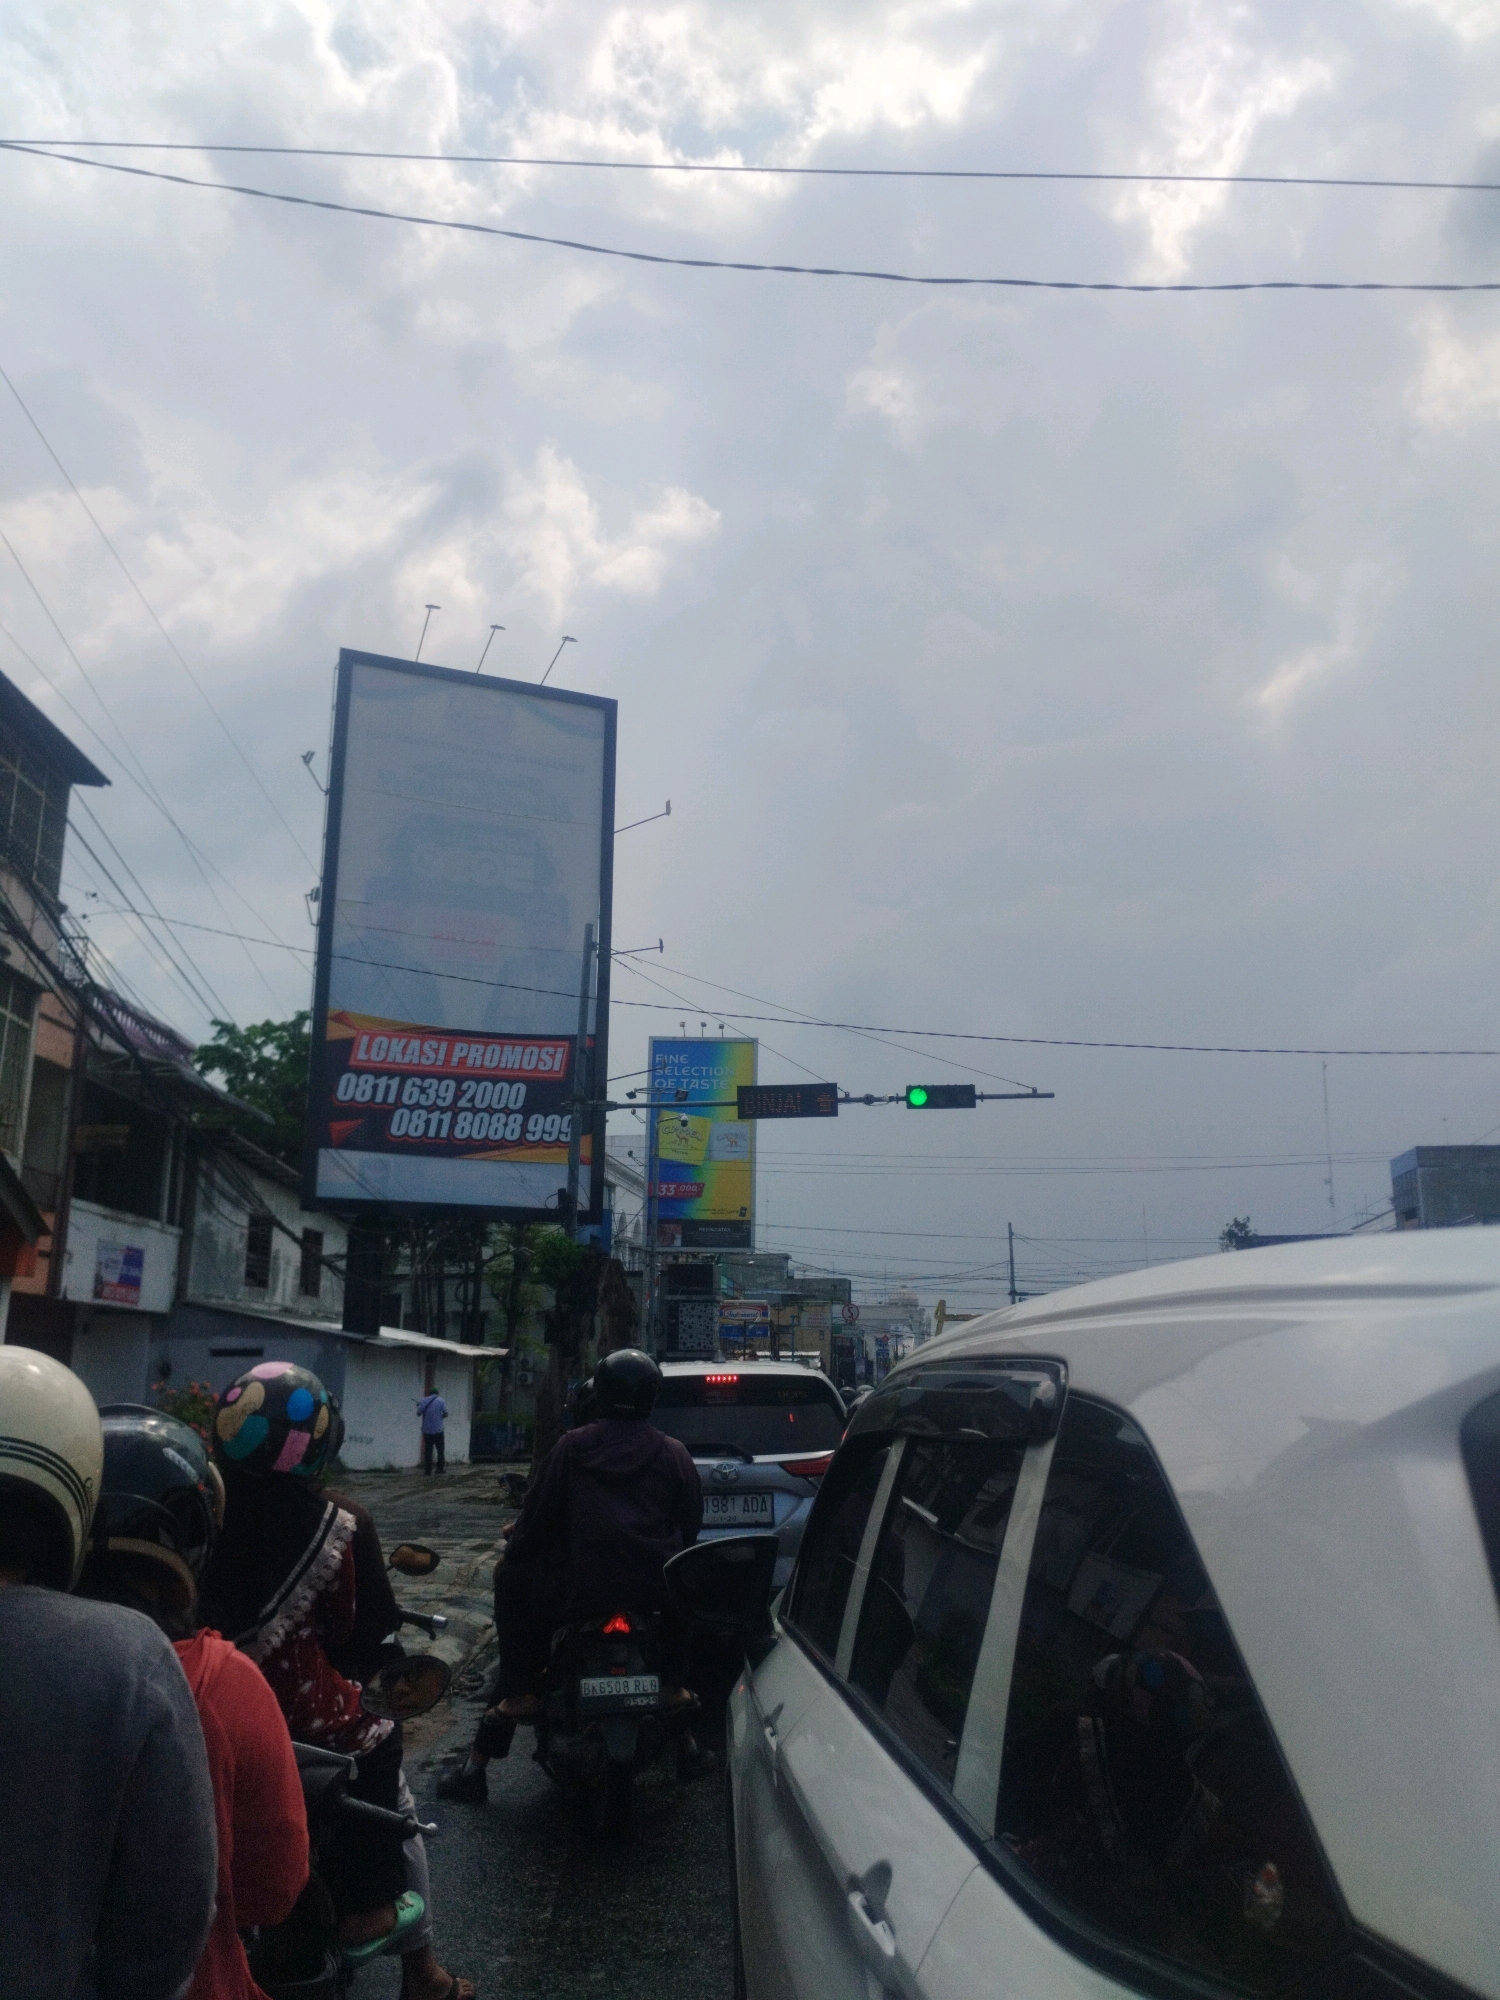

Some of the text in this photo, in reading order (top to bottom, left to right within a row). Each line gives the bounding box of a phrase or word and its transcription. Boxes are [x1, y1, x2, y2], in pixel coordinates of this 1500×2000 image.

[357, 1034, 565, 1072] LOKASI PROMOSI
[655, 1054, 689, 1064] FINE
[654, 1066, 735, 1077] SELECTION
[336, 1073, 527, 1110] 0811 639 2000
[681, 1078, 729, 1090] TASTE
[744, 1093, 802, 1114] BINJAI
[390, 1108, 573, 1143] 0811 8088 999
[743, 1496, 768, 1513] ADA
